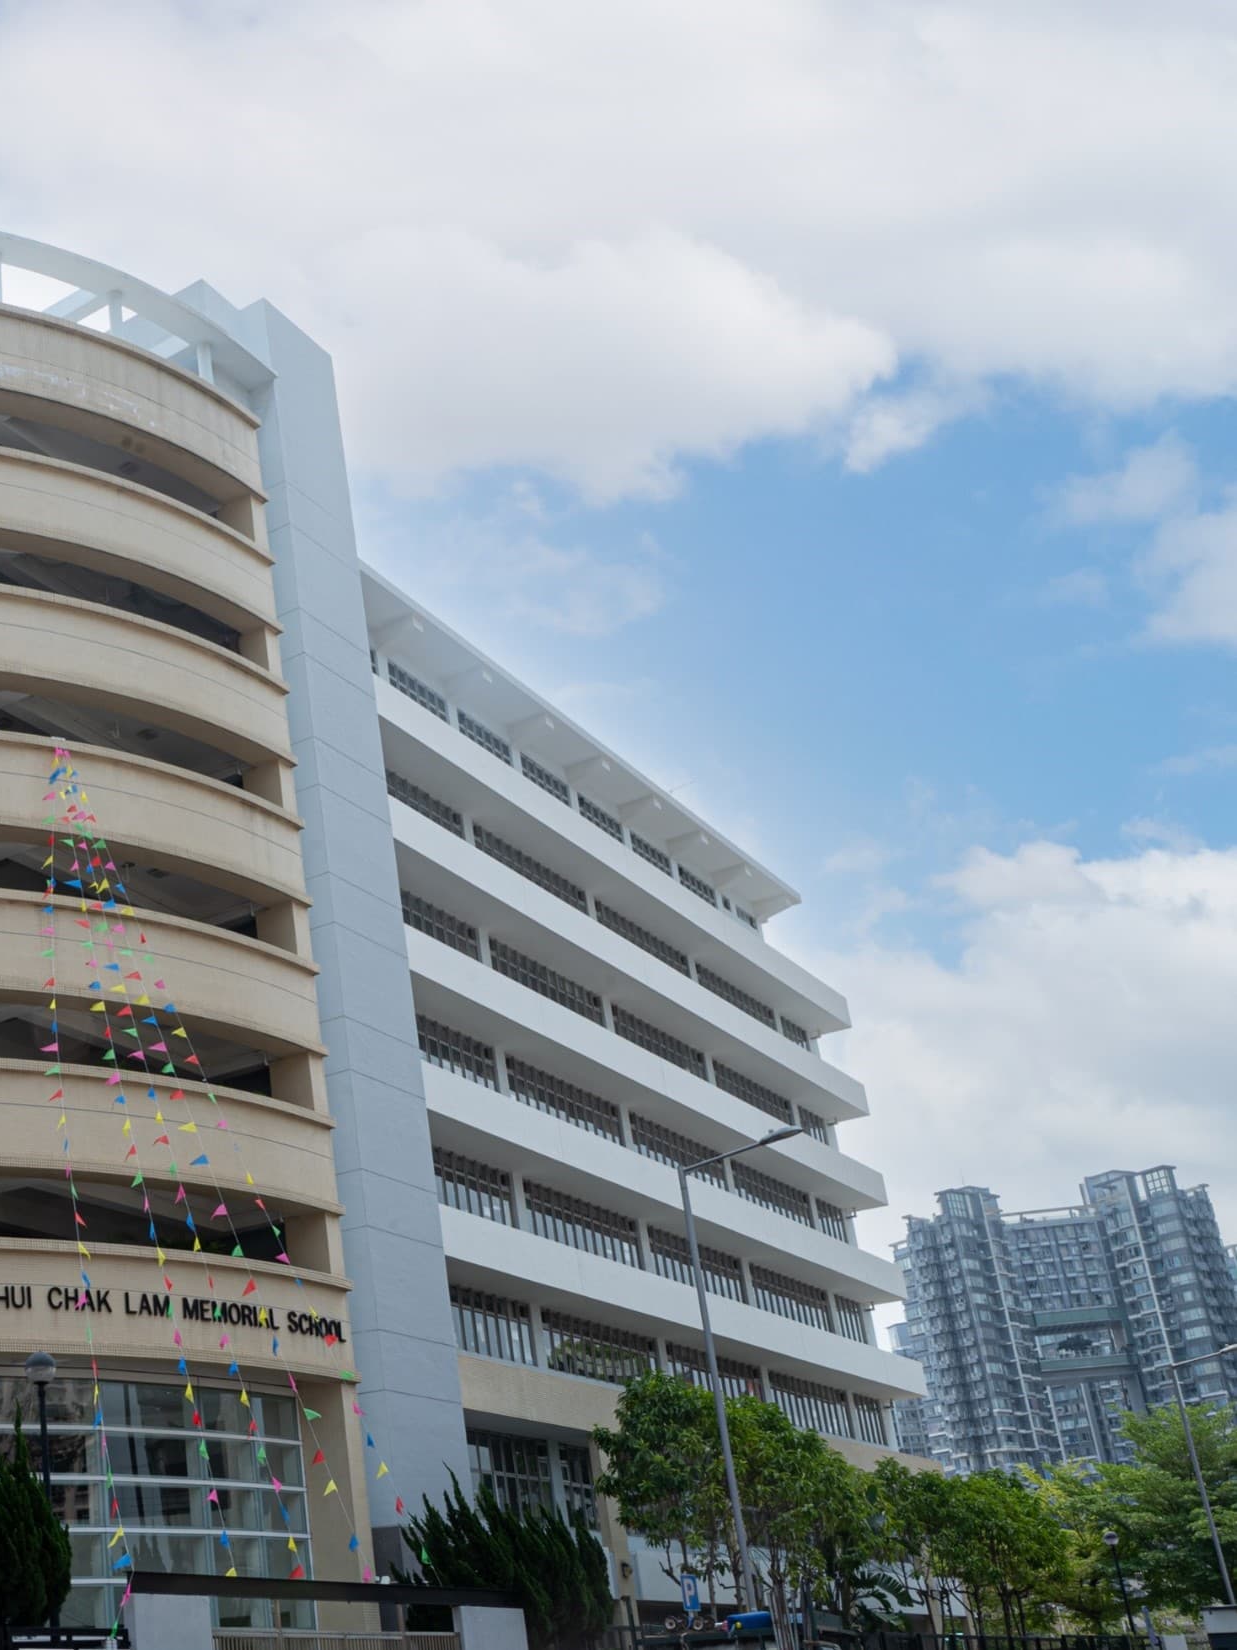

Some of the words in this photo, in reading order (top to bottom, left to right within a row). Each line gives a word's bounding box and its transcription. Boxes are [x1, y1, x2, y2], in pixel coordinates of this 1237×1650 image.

[47, 1287, 112, 1313] CHAK
[124, 1292, 173, 1318] LAM
[287, 1311, 346, 1343] SCHOOL
[683, 1578, 695, 1607] P
